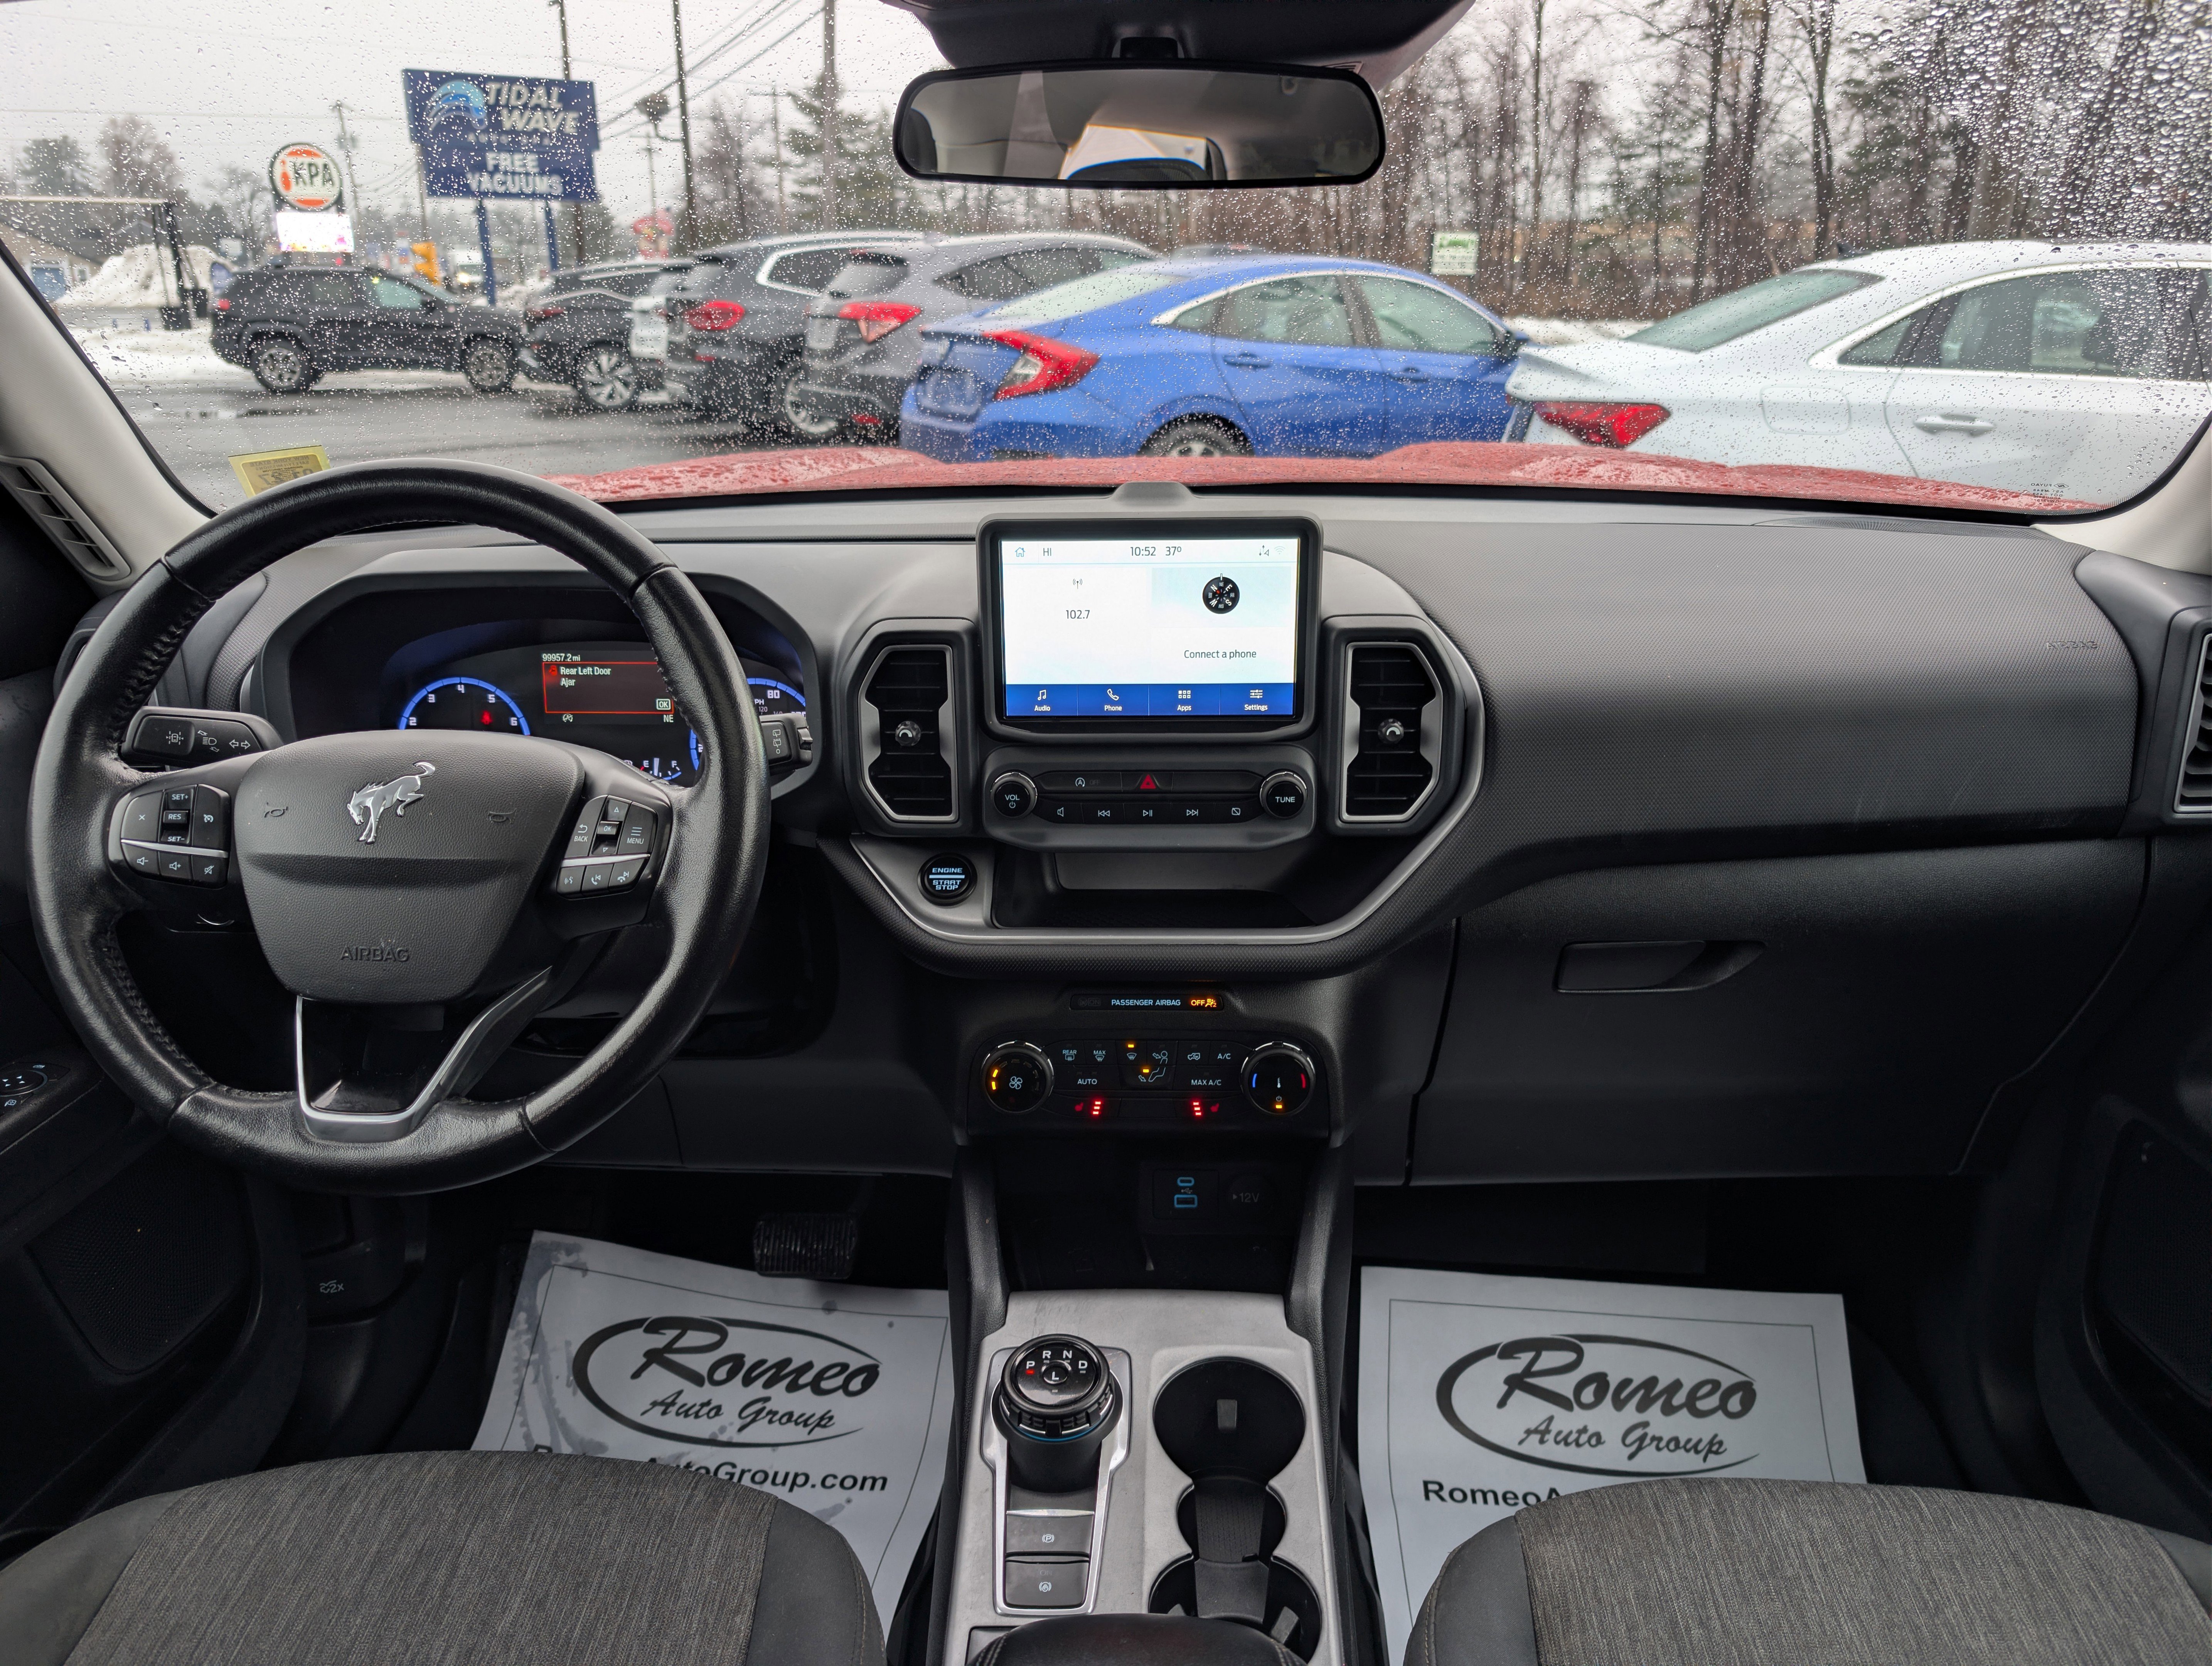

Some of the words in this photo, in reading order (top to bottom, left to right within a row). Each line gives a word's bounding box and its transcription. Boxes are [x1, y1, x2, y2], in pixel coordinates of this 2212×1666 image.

[486, 81, 563, 108] TIDAL
[502, 108, 580, 134] WAVE
[485, 152, 539, 173] FREE
[465, 172, 564, 194] VACUUMS
[1043, 548, 1051, 556] HI
[1130, 546, 1156, 557] 10:52
[1066, 609, 1090, 619] 102.7
[542, 653, 572, 662] 99957.2
[1184, 649, 1220, 659] Connect
[1229, 649, 1257, 660] phone
[560, 667, 577, 675] Rear
[579, 667, 593, 675] Left
[594, 667, 611, 675] Door
[561, 678, 576, 688] Ajar
[457, 684, 465, 693] 4
[427, 694, 435, 703] 3
[488, 694, 495, 703] 5
[767, 690, 780, 699] 80
[1177, 704, 1192, 713] Apps
[1244, 703, 1268, 712] Settings
[409, 717, 417, 726] 2
[510, 717, 518, 726] 6
[627, 837, 644, 845] MENU
[340, 945, 409, 962] AIRBAG
[1239, 1193, 1259, 1203] 12V
[630, 1316, 881, 1397] Romeo
[1043, 1350, 1051, 1359] R
[1063, 1350, 1072, 1359] N
[1026, 1361, 1035, 1369] P
[1078, 1360, 1088, 1369] D
[1052, 1371, 1059, 1380] L
[1496, 1336, 1757, 1419] Romeo
[640, 1389, 724, 1418] Auto
[738, 1396, 836, 1436] Group
[1518, 1415, 1606, 1448] Auto
[1621, 1420, 1727, 1463] Group
